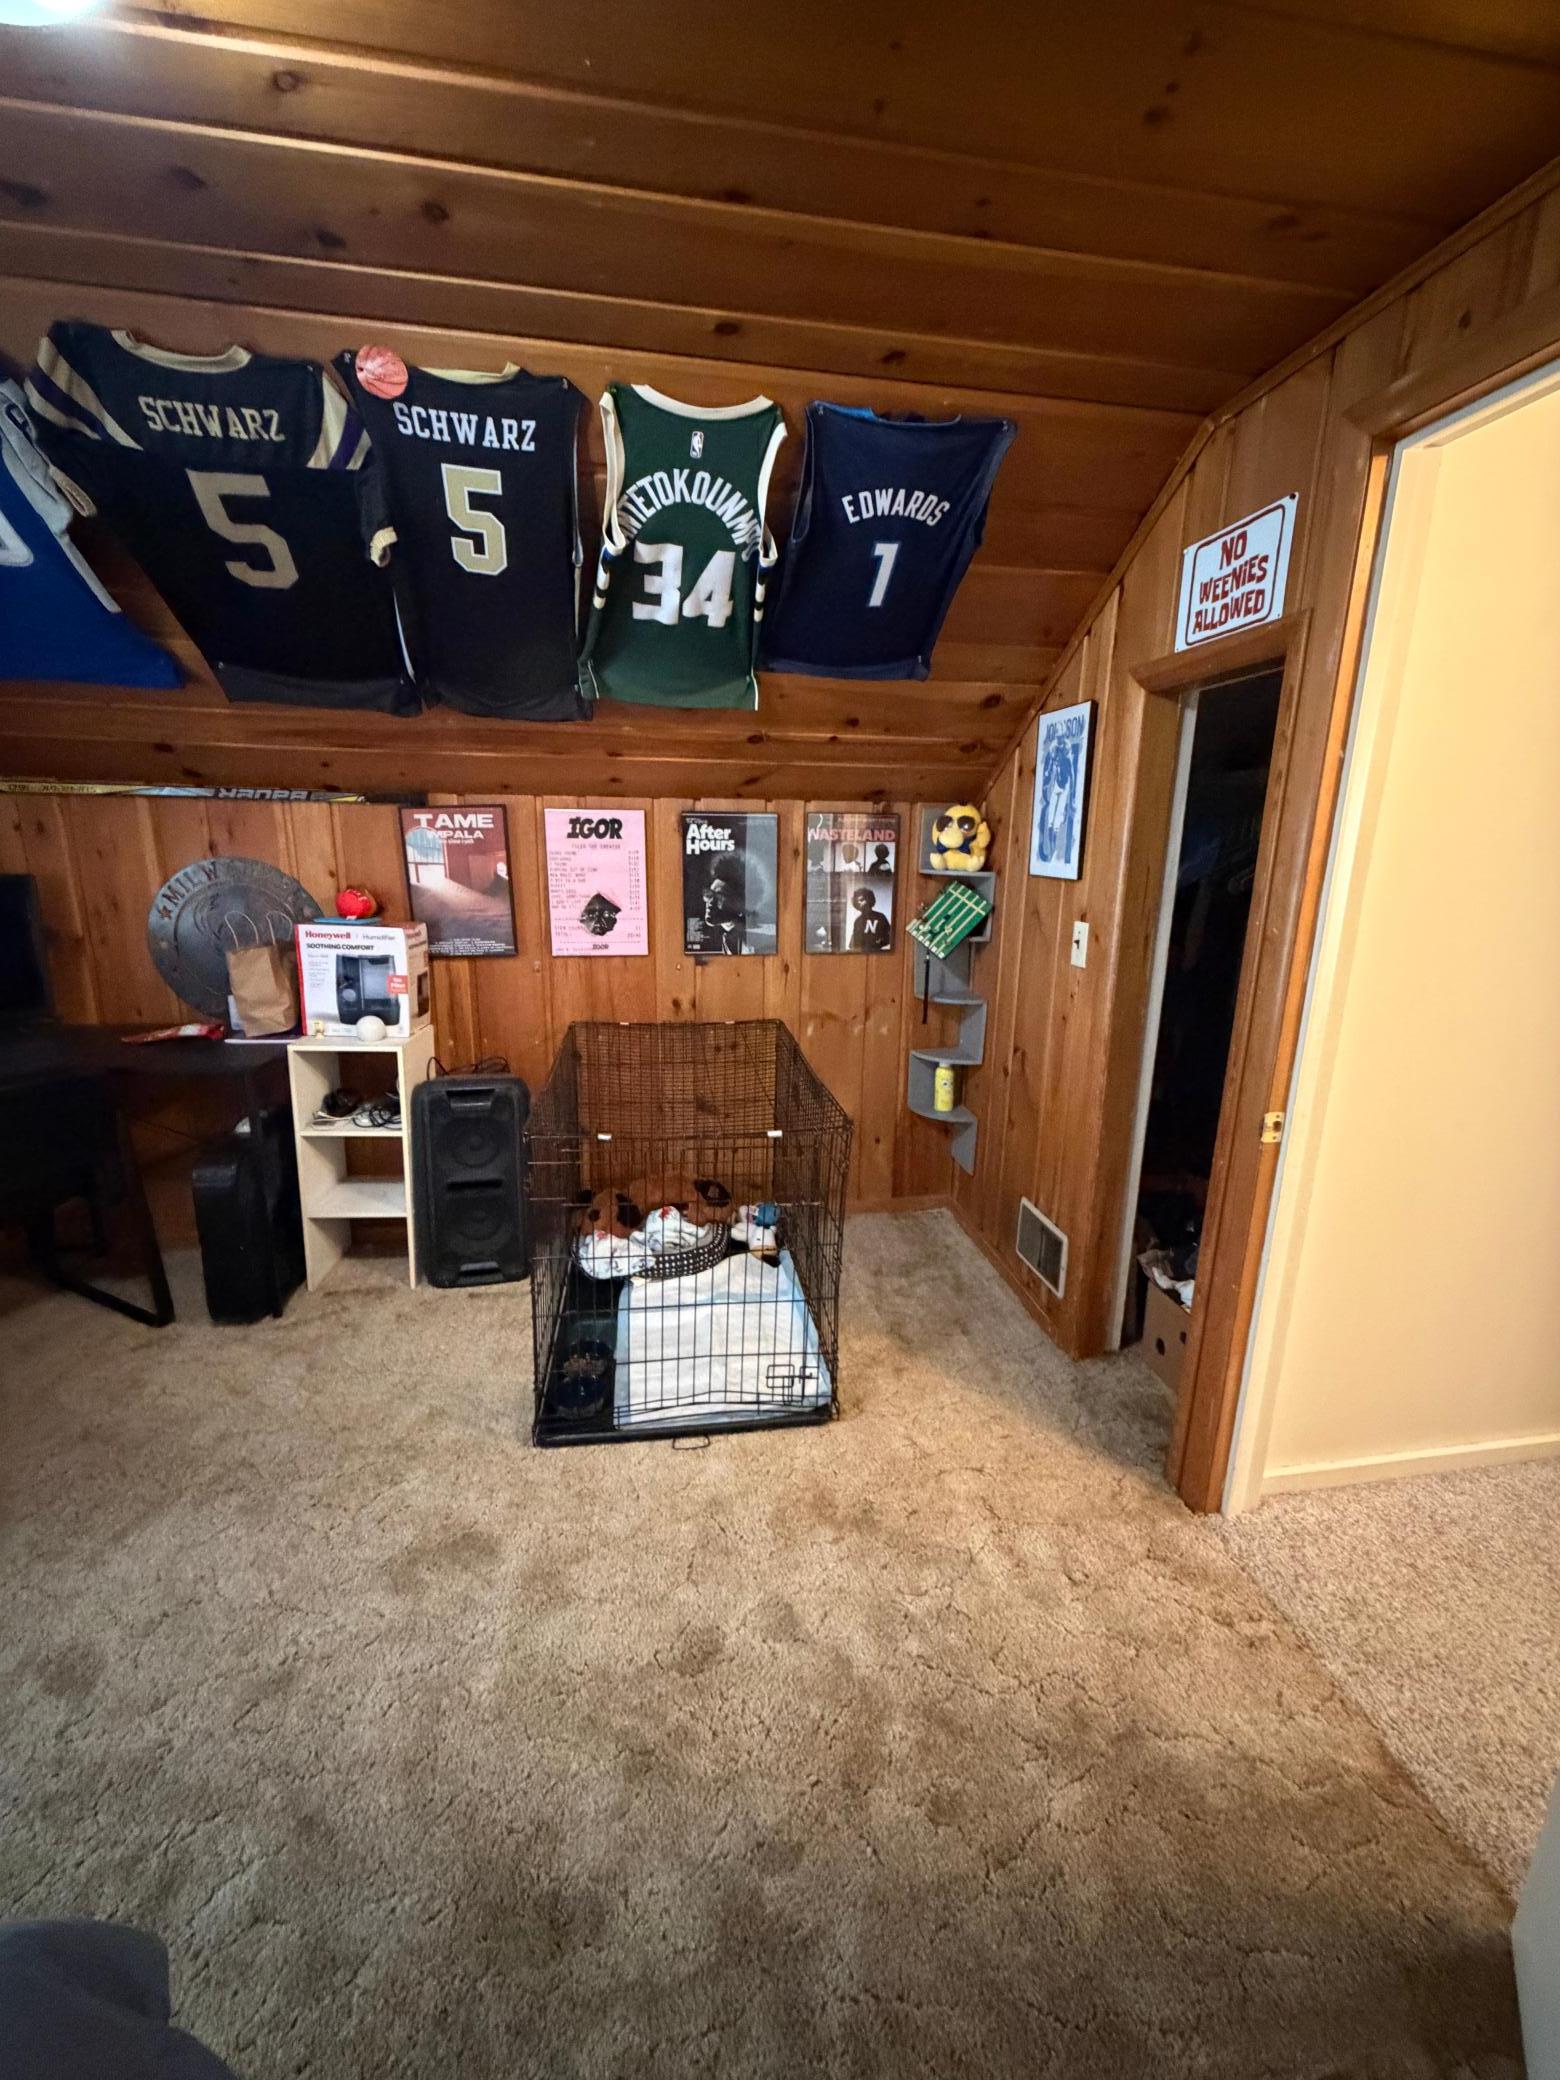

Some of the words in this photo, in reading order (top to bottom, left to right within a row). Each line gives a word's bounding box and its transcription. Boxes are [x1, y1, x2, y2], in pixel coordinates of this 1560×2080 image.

[138, 395, 285, 442] SCHWARZ
[393, 402, 536, 452] SCHWARZ
[441, 462, 508, 576] 5
[841, 488, 950, 527] EDWARDS
[186, 468, 299, 590] 5
[1219, 530, 1248, 570] NO
[632, 541, 736, 628] 34
[868, 543, 899, 608] 1
[1192, 589, 1266, 634] ALLOWED
[1044, 714, 1085, 745] JOSON
[413, 813, 495, 829] TAME
[566, 816, 623, 840] IGOR
[686, 823, 732, 840] After
[807, 827, 896, 843] WASTELAND
[685, 839, 735, 855] Hours
[305, 931, 352, 941] Honeywell
[306, 942, 341, 950] SOOTHING
[341, 943, 375, 951] COMFORT
